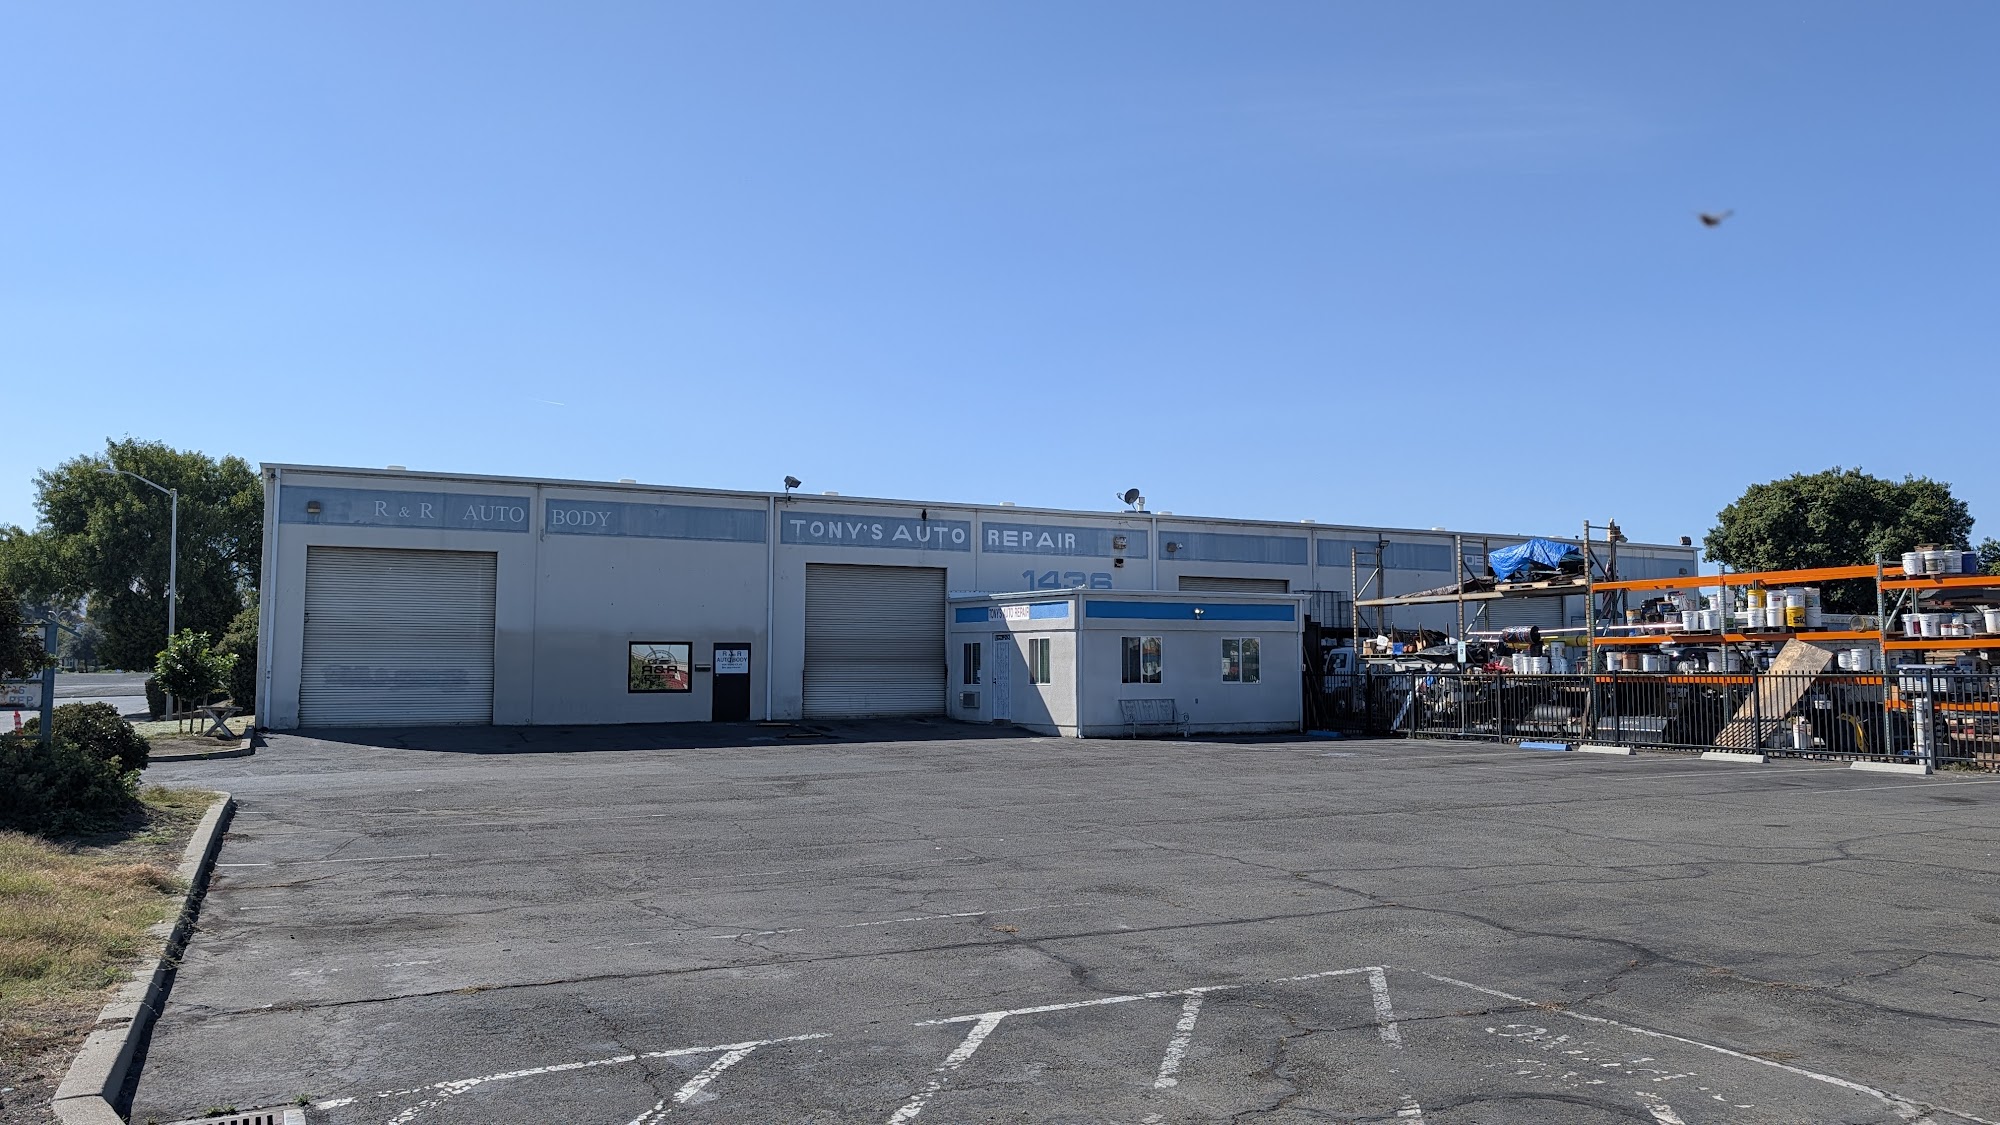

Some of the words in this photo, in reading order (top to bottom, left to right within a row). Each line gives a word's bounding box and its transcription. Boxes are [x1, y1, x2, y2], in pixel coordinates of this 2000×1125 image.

[374, 500, 389, 517] R
[398, 506, 410, 518] &
[420, 502, 434, 519] R
[463, 504, 525, 523] AUTO
[551, 508, 612, 527] BODY
[789, 519, 883, 541] TONY'S
[892, 523, 966, 544] AUTO
[987, 528, 1076, 549] REPAIR
[1021, 569, 1113, 591] 1436
